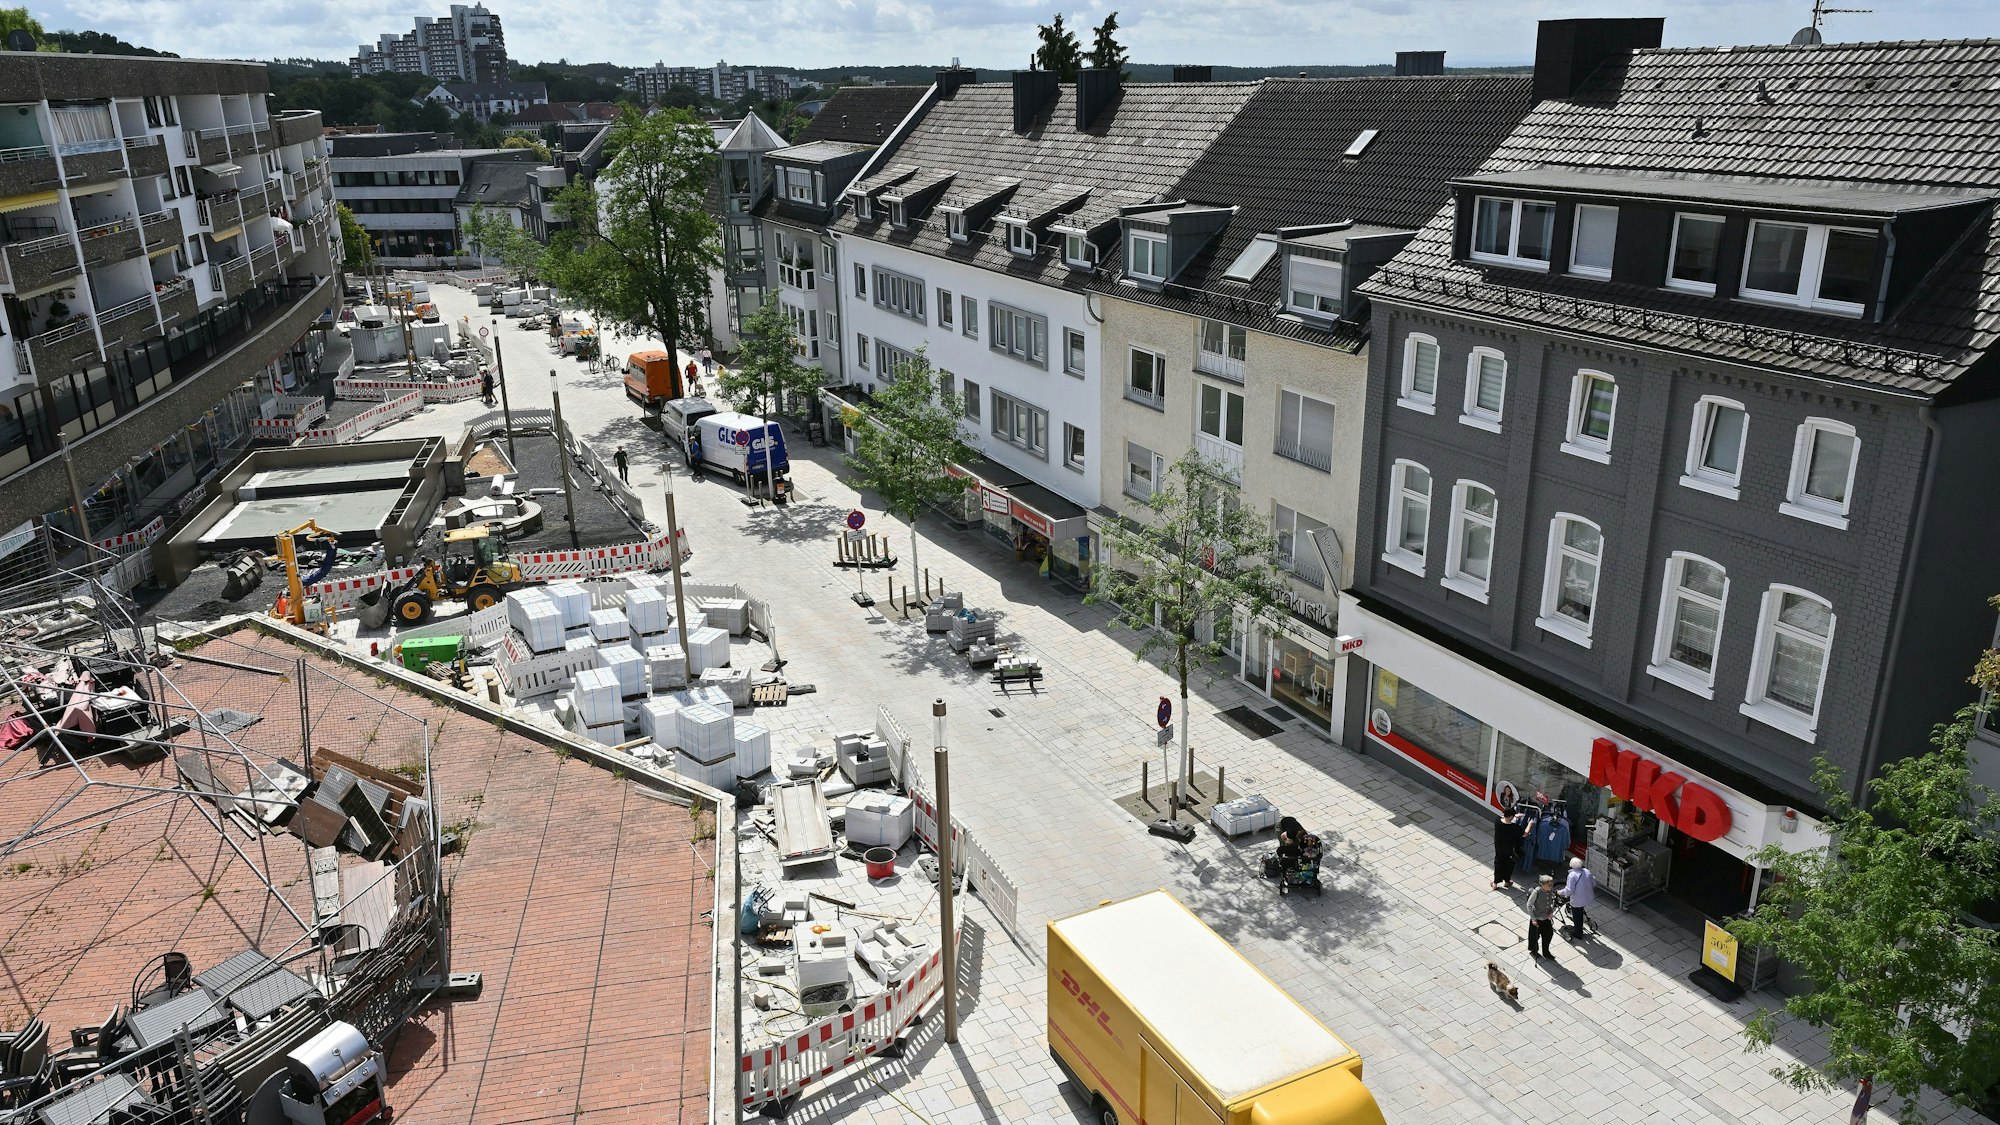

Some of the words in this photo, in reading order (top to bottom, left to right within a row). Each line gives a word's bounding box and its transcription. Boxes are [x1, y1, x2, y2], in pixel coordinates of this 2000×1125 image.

[718, 427, 736, 445] GLS
[1342, 639, 1363, 651] NKD
[1589, 737, 1732, 842] NKD
[1710, 937, 1731, 955] 50%
[1061, 969, 1113, 1036] DHL
